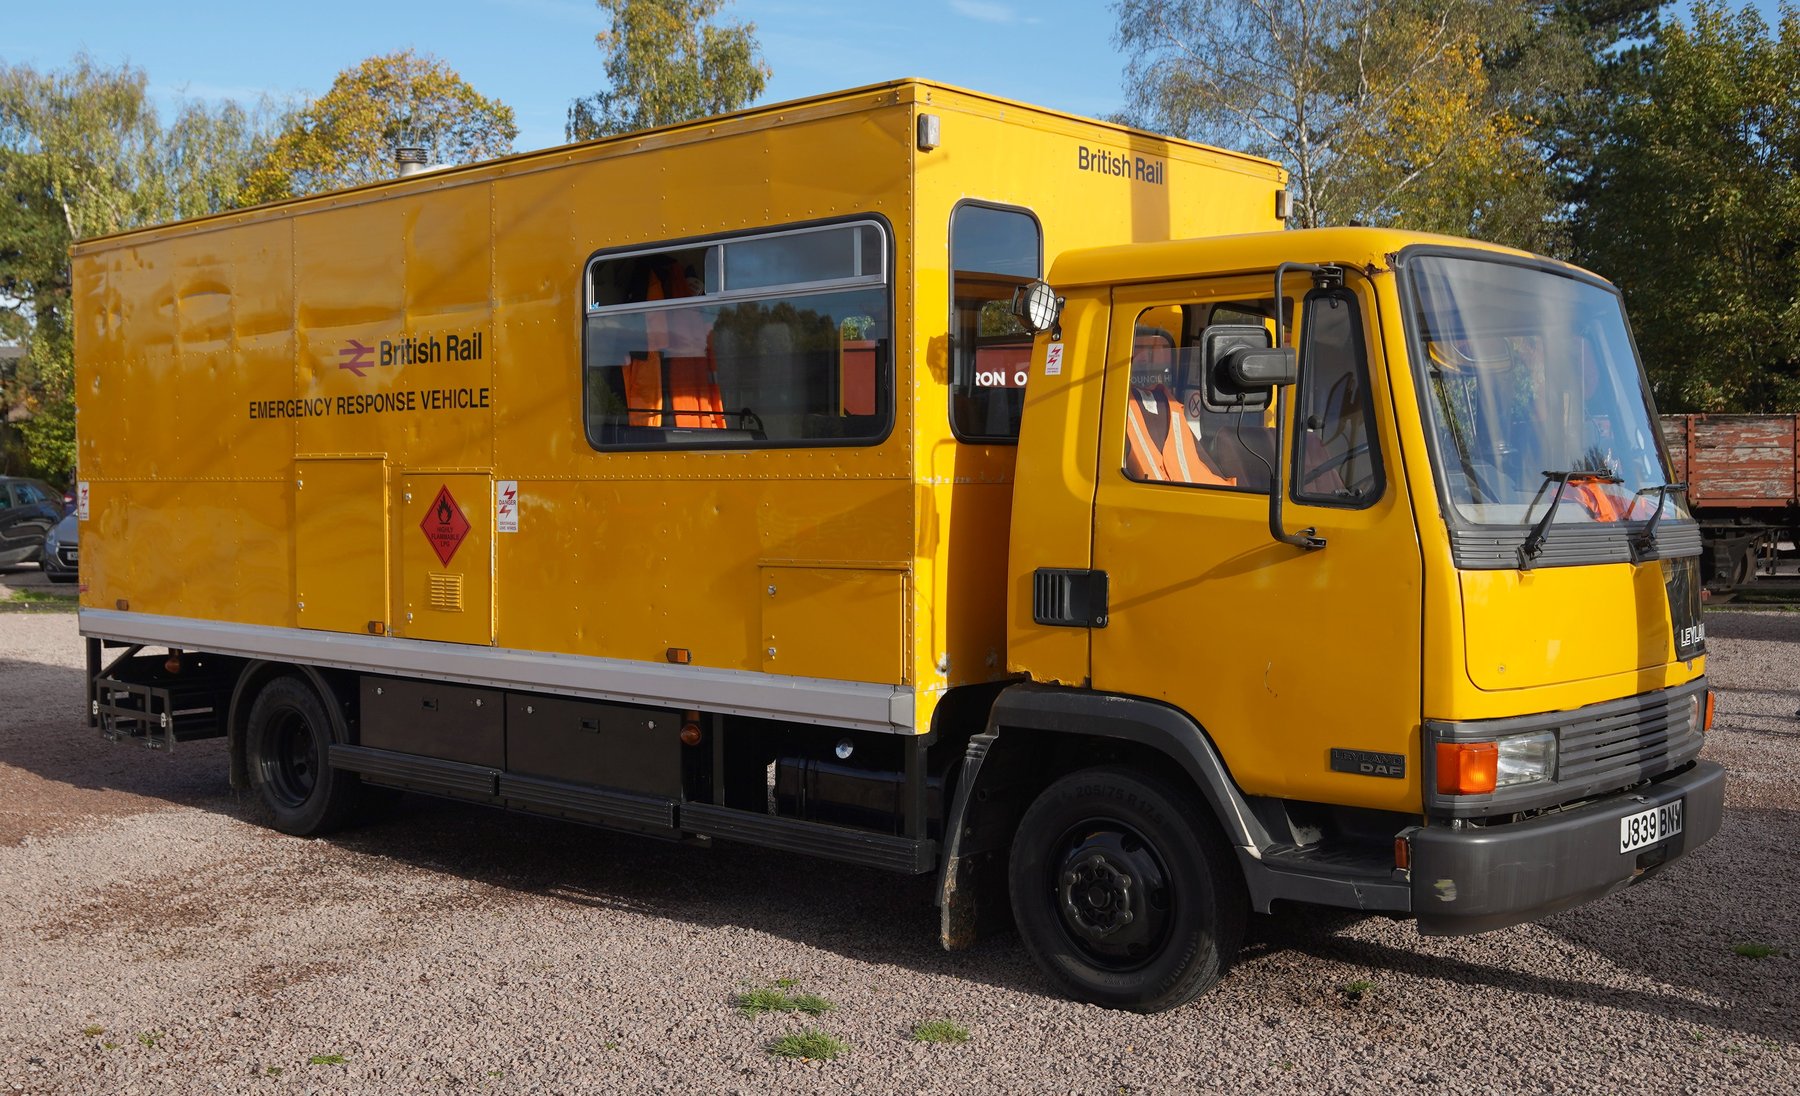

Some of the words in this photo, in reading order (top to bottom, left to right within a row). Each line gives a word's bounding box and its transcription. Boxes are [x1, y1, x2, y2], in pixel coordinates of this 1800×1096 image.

[1078, 145, 1131, 178] British
[1135, 156, 1163, 185] Rail
[380, 335, 441, 367] British
[446, 332, 482, 361] Rail
[249, 396, 332, 419] EMERGENCY
[336, 391, 416, 415] RESPONSE
[420, 387, 490, 410] VEHICLE
[431, 532, 460, 541] FLAMMABLE
[436, 526, 453, 534] HIGHLY
[1332, 750, 1403, 765] LEYLAND
[1360, 763, 1403, 775] DAF
[1075, 784, 1125, 800] 205/75
[1622, 812, 1657, 849] J839
